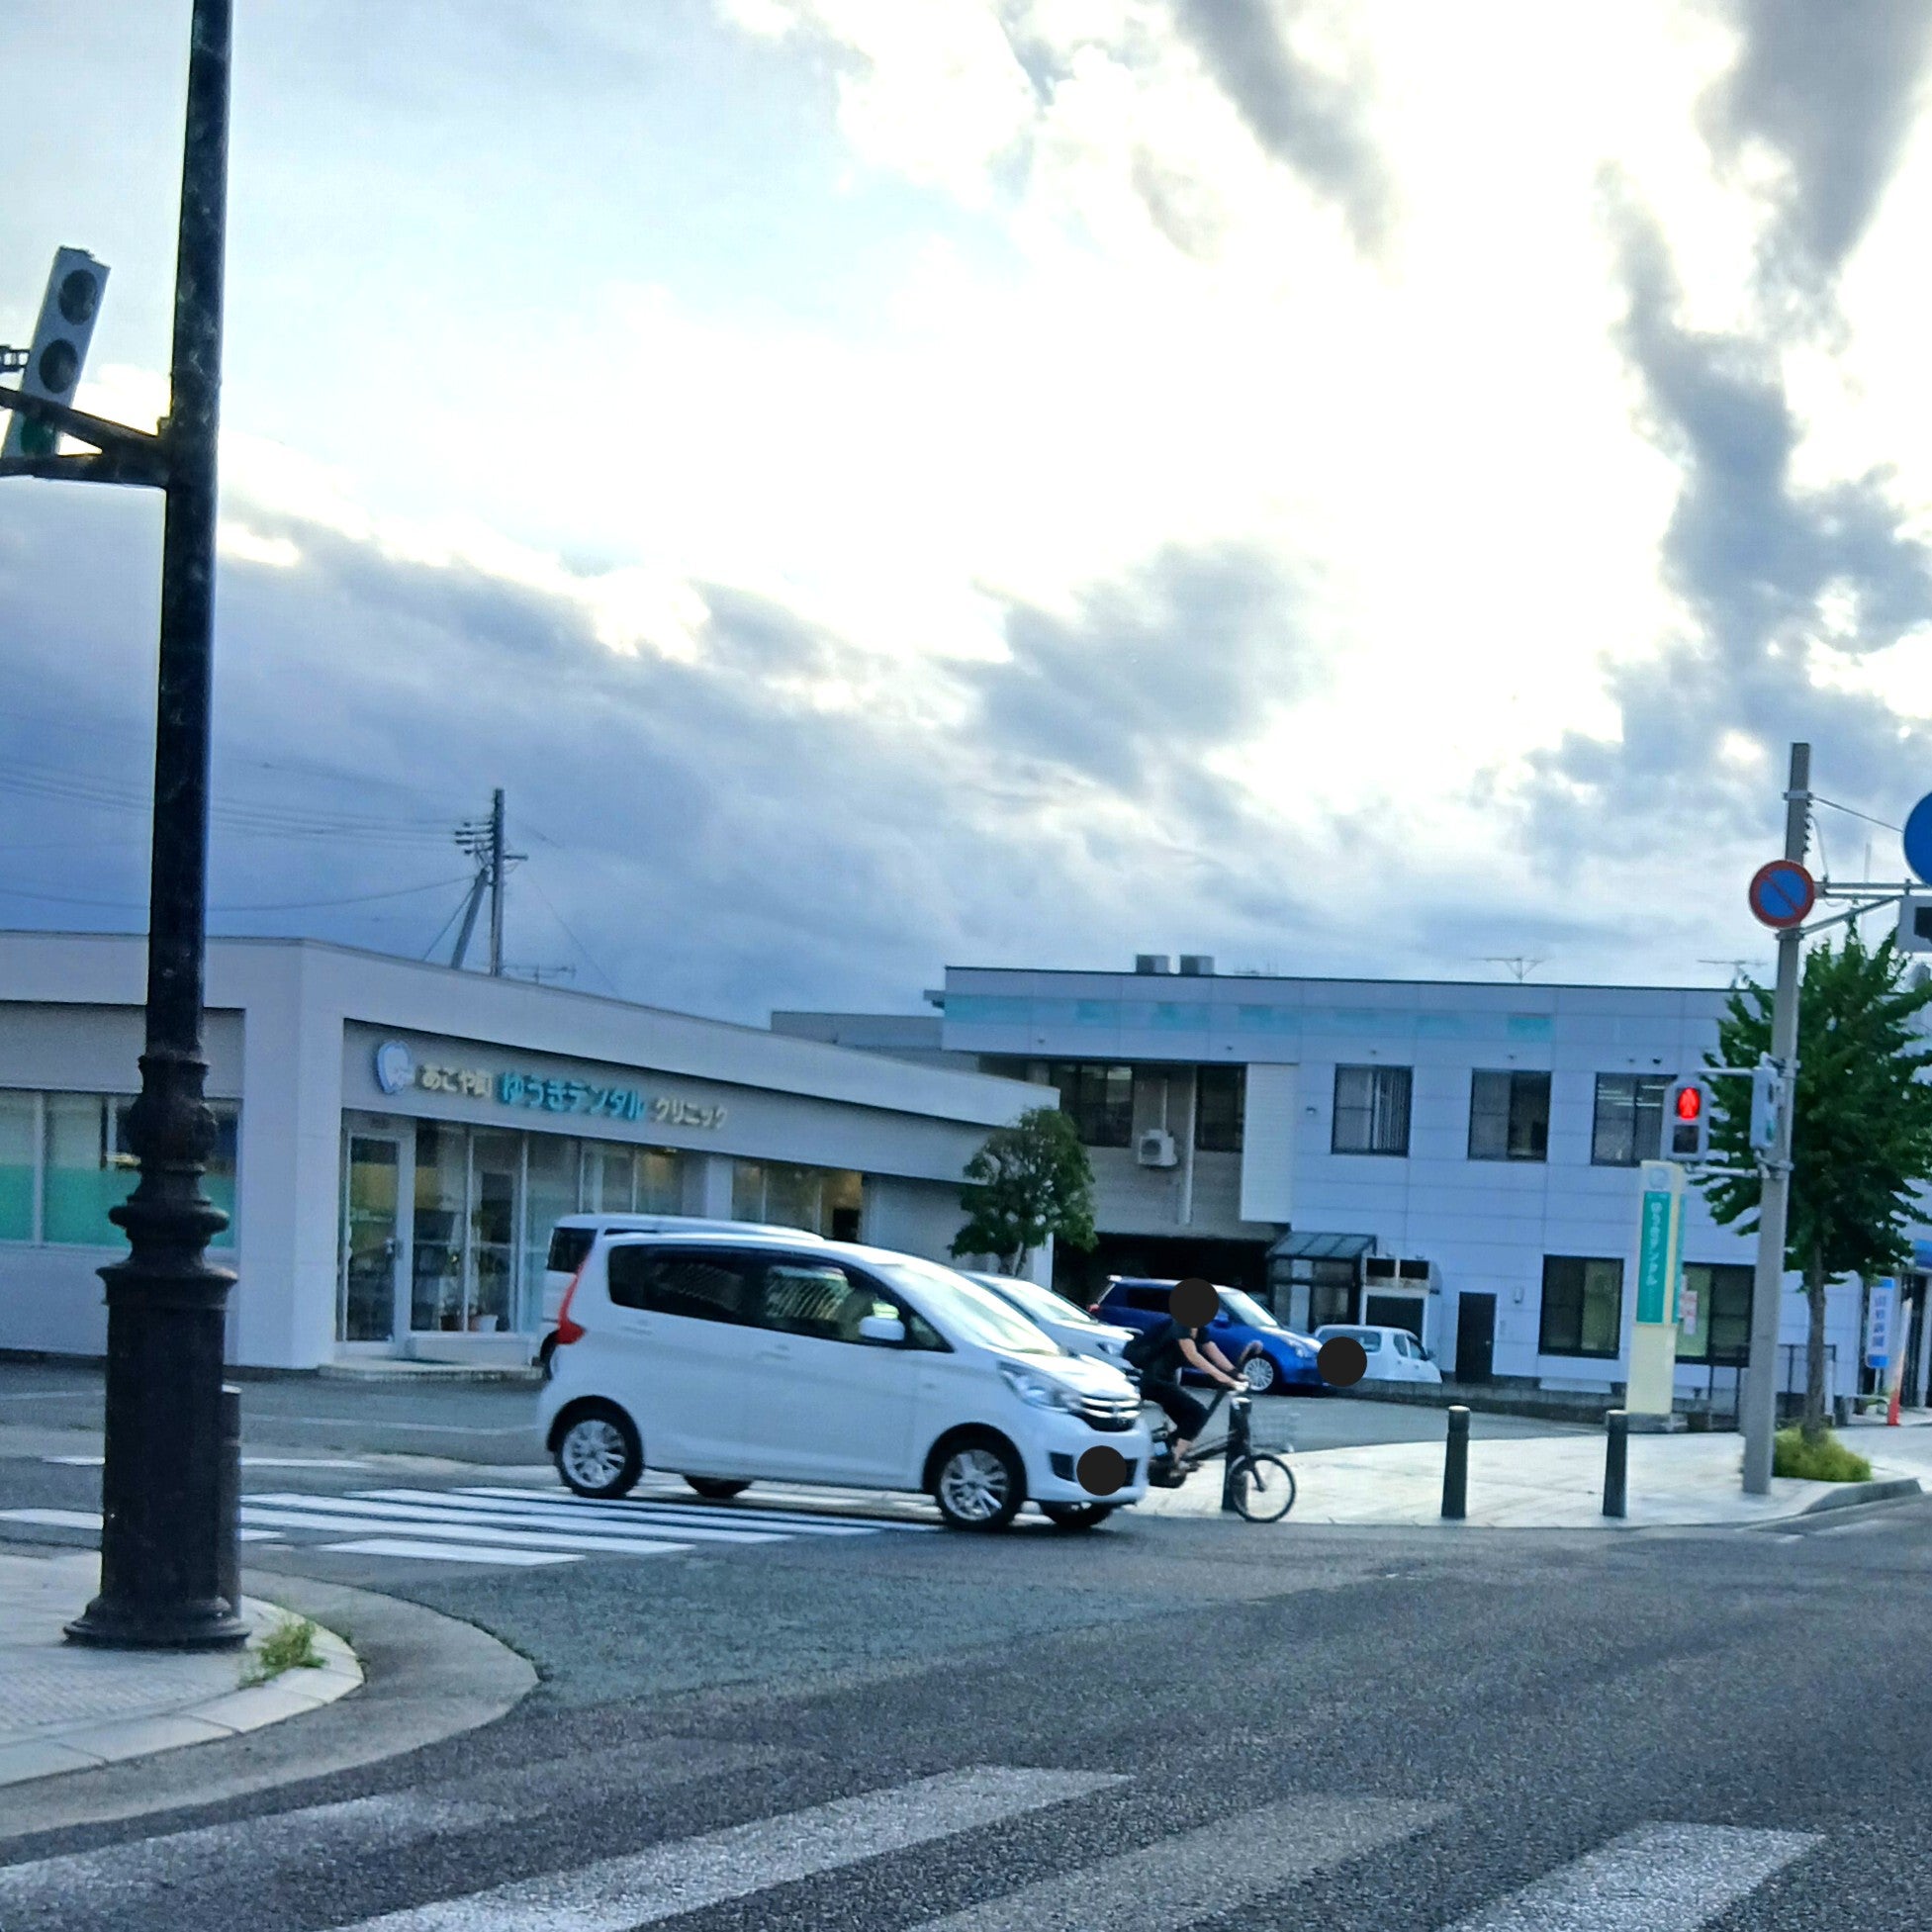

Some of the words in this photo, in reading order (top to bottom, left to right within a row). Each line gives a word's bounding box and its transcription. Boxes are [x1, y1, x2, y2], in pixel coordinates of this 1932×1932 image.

[421, 1062, 494, 1098] あこや町
[502, 1072, 646, 1121] ゆうきデンタル
[655, 1098, 728, 1130] クリニック
